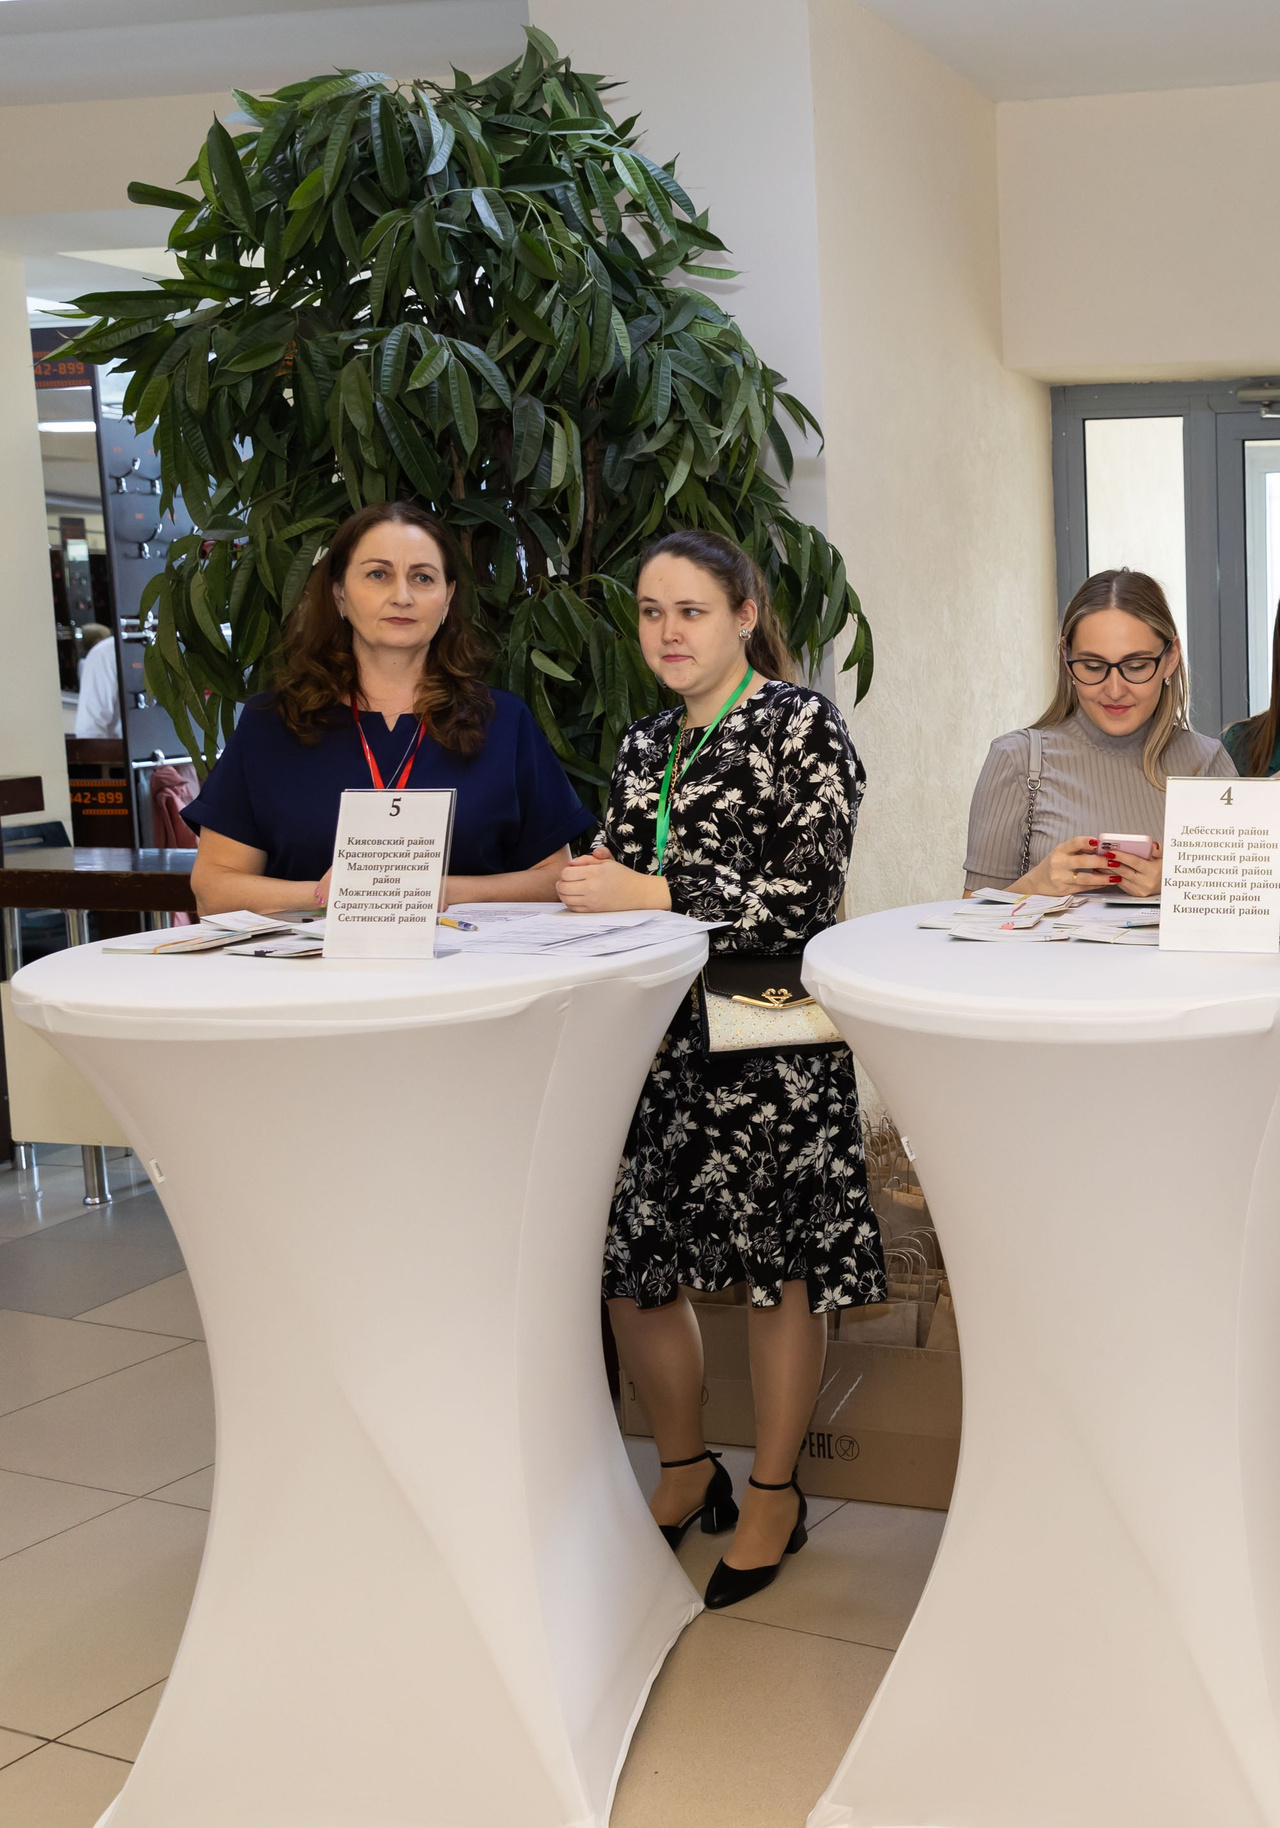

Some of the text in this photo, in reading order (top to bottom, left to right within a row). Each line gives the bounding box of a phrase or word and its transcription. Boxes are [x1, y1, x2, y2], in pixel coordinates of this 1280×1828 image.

[1220, 786, 1233, 805] 4
[389, 797, 401, 817] 5
[1181, 826, 1269, 837] Дебёсский район
[347, 837, 435, 847] Киясовский район
[1171, 838, 1278, 850] Завьяловский район
[338, 850, 441, 860] Красногорский район
[1178, 852, 1270, 863] Игринский район
[347, 862, 429, 873] Малопургинский
[1174, 865, 1272, 877] Камбарский район
[372, 875, 400, 885] район
[1164, 878, 1247, 889] Каракулинский
[339, 888, 431, 898] Можгинский район
[1184, 892, 1260, 903] Кезский район
[334, 901, 433, 911] Сарапульский район
[1173, 905, 1269, 916] Кизнерский район
[338, 913, 426, 924] Селтинский район
